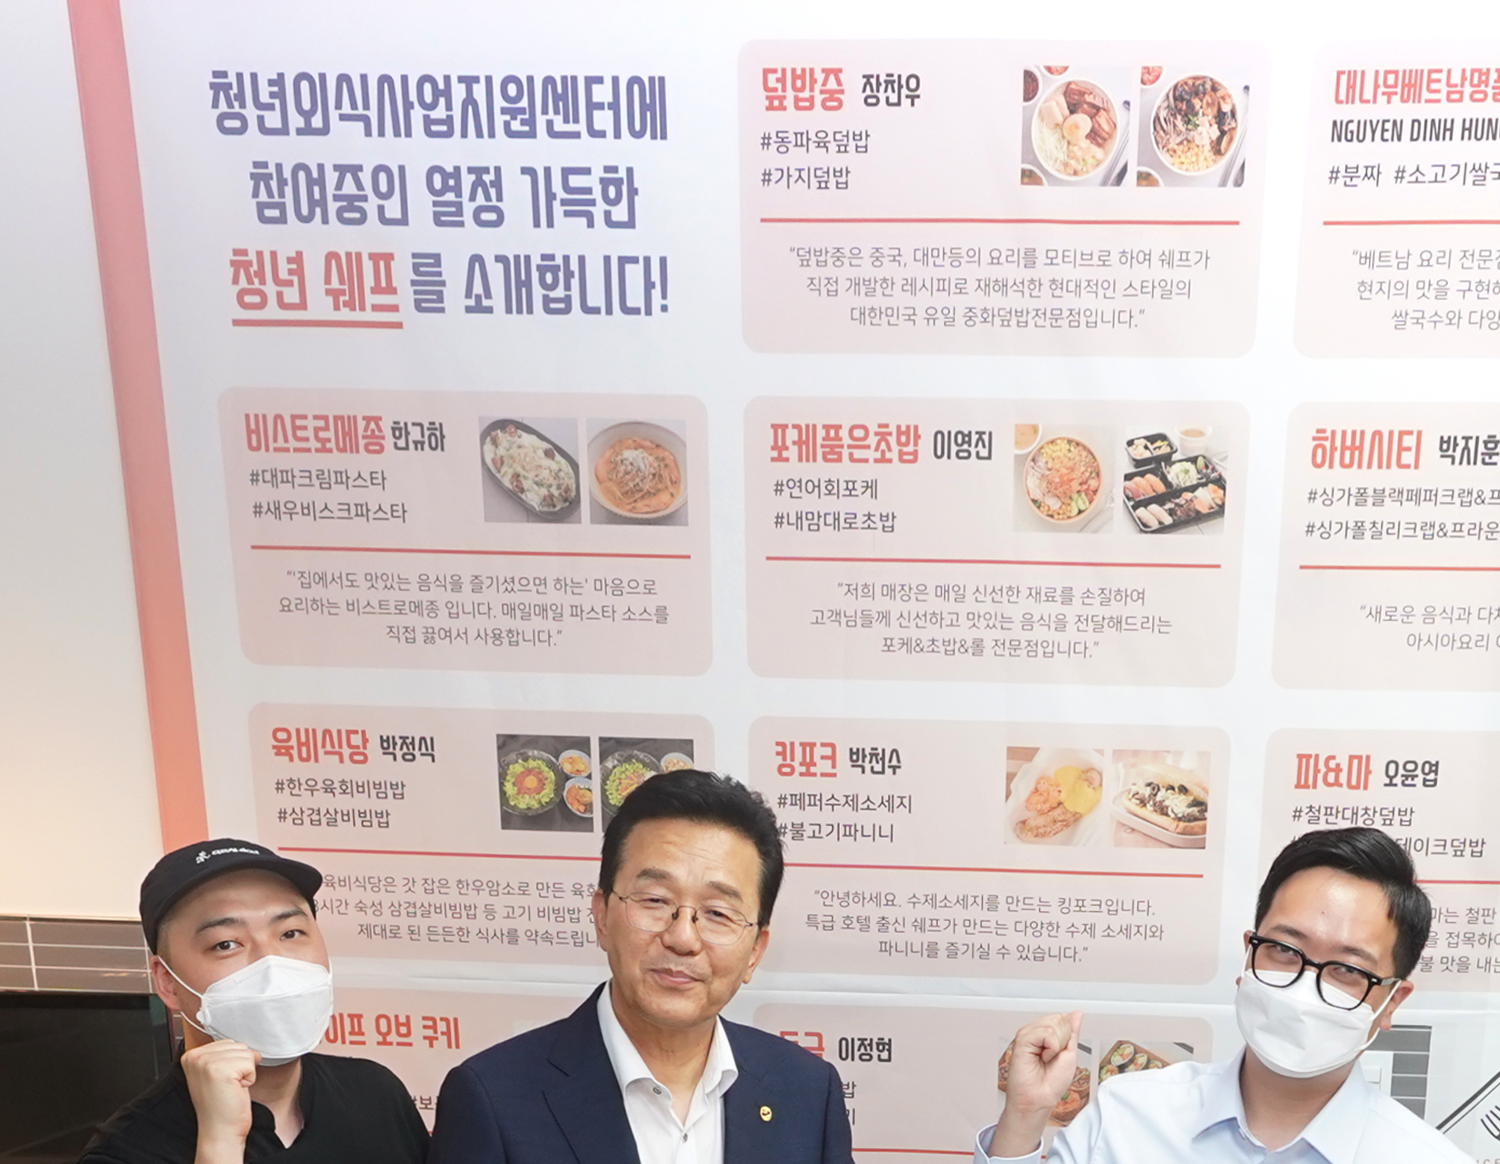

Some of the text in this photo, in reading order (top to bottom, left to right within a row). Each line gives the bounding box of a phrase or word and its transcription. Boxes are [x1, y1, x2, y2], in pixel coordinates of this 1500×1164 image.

[762, 67, 921, 111] 덮밥중 장찬우
[209, 70, 668, 141] 청년외식사업지원센터에
[1331, 119, 1403, 143] NGUYEN
[1410, 119, 1455, 143] DINH
[250, 161, 638, 230] 참여중인 열정 가득한
[869, 247, 1211, 269] 중국, 대만등의 요리를 모티브로 하여 쉐프가
[1418, 249, 1452, 270] 요리
[230, 248, 668, 316] 청년 쉐프 를 소개합니다!
[806, 276, 1192, 299] 직접 개발한 레시피로 재해석한 현대적인 스타일의
[1357, 279, 1409, 300] 현지의
[1415, 279, 1450, 300] 맛을
[850, 306, 957, 327] 대한민국 유일
[1391, 309, 1462, 330] 쌀국수와
[245, 413, 445, 454] 비스트로메종 한규하
[770, 423, 993, 465] 포케품은초밥 이영진
[1311, 429, 1500, 471] 하버시티 박지훈
[364, 572, 656, 596] 맛있는 음식을 즐기셨으면 하는' 마음으로
[881, 583, 1145, 607] 매장은 매일 신선한 재료를 손질하여
[279, 597, 669, 624] 요리하는 비스트로메종 입니다. 매일매일 파스타 소스를
[810, 609, 1172, 634] 고객님들께 신선하고 맛있는 음식을 전달해드리는
[1421, 606, 1472, 625] 음식과
[386, 625, 469, 645] 직접 끓여서
[881, 636, 985, 657] 포케&초밥&롤
[1407, 633, 1490, 653] 아시아요리
[271, 727, 435, 765] 육비식당 박정식
[775, 741, 902, 778] 킹포크 박천수
[1294, 753, 1440, 791] 파&마 오윤엽
[323, 874, 566, 898] 육비식당은 잡은 한우암소로 만든
[388, 901, 478, 920] 삼겹살비빔밥
[536, 906, 581, 923] 비빔밥
[907, 892, 1155, 916] 수제소세지를 만드는 킹포크입니다.
[358, 924, 520, 945] 제대로 든든한 식사를
[912, 916, 1164, 941] 쉐프가 만드는 다양한 소세지와
[878, 940, 991, 960] 파니니를 즐기실
[375, 1014, 460, 1049] 오브 쿠키
[838, 1036, 892, 1063] 이정현
